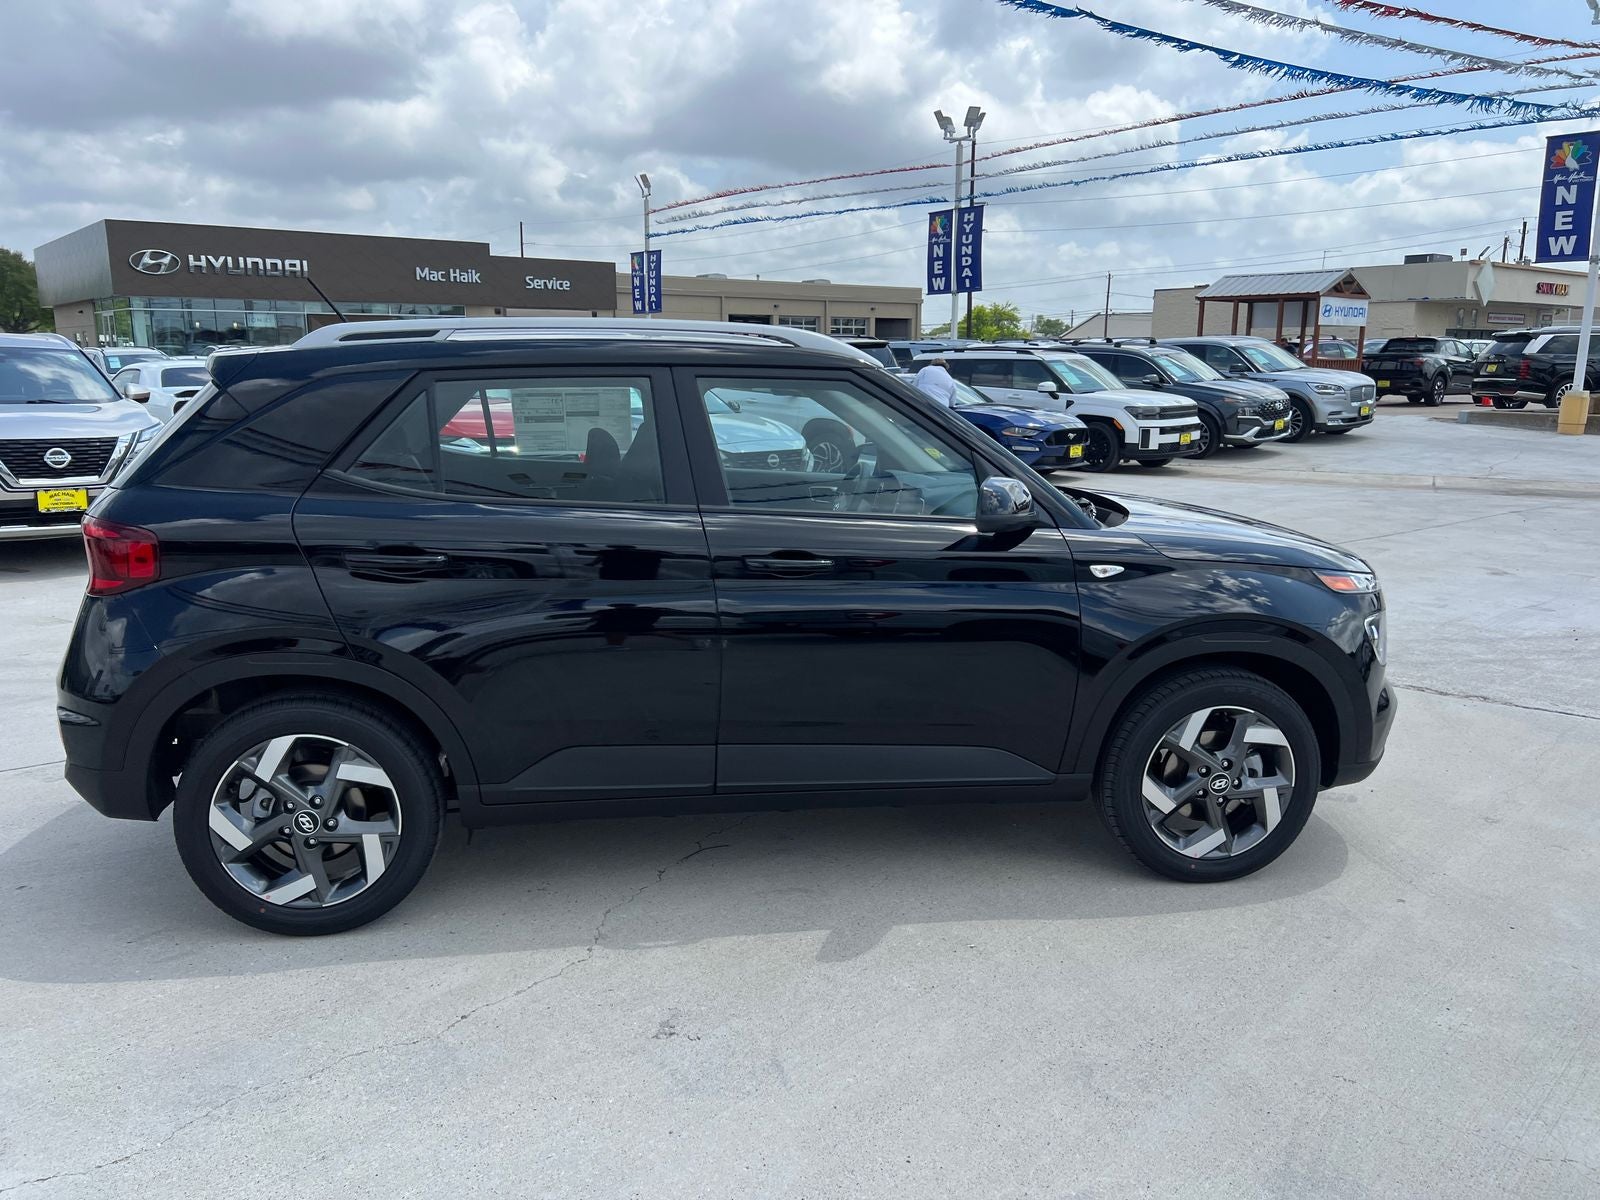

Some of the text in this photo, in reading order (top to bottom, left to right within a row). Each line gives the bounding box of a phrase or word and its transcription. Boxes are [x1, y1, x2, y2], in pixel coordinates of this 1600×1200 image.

[1548, 185, 1577, 256] NEW
[188, 254, 308, 278] HYUNDAI
[932, 244, 945, 291] NEW
[961, 212, 975, 288] HYUNDAI
[416, 267, 481, 283] Mac Haik
[525, 276, 570, 290] Service
[649, 254, 657, 310] HYUNDAI
[633, 276, 642, 311] NEW
[1334, 306, 1366, 318] HYUNDAI
